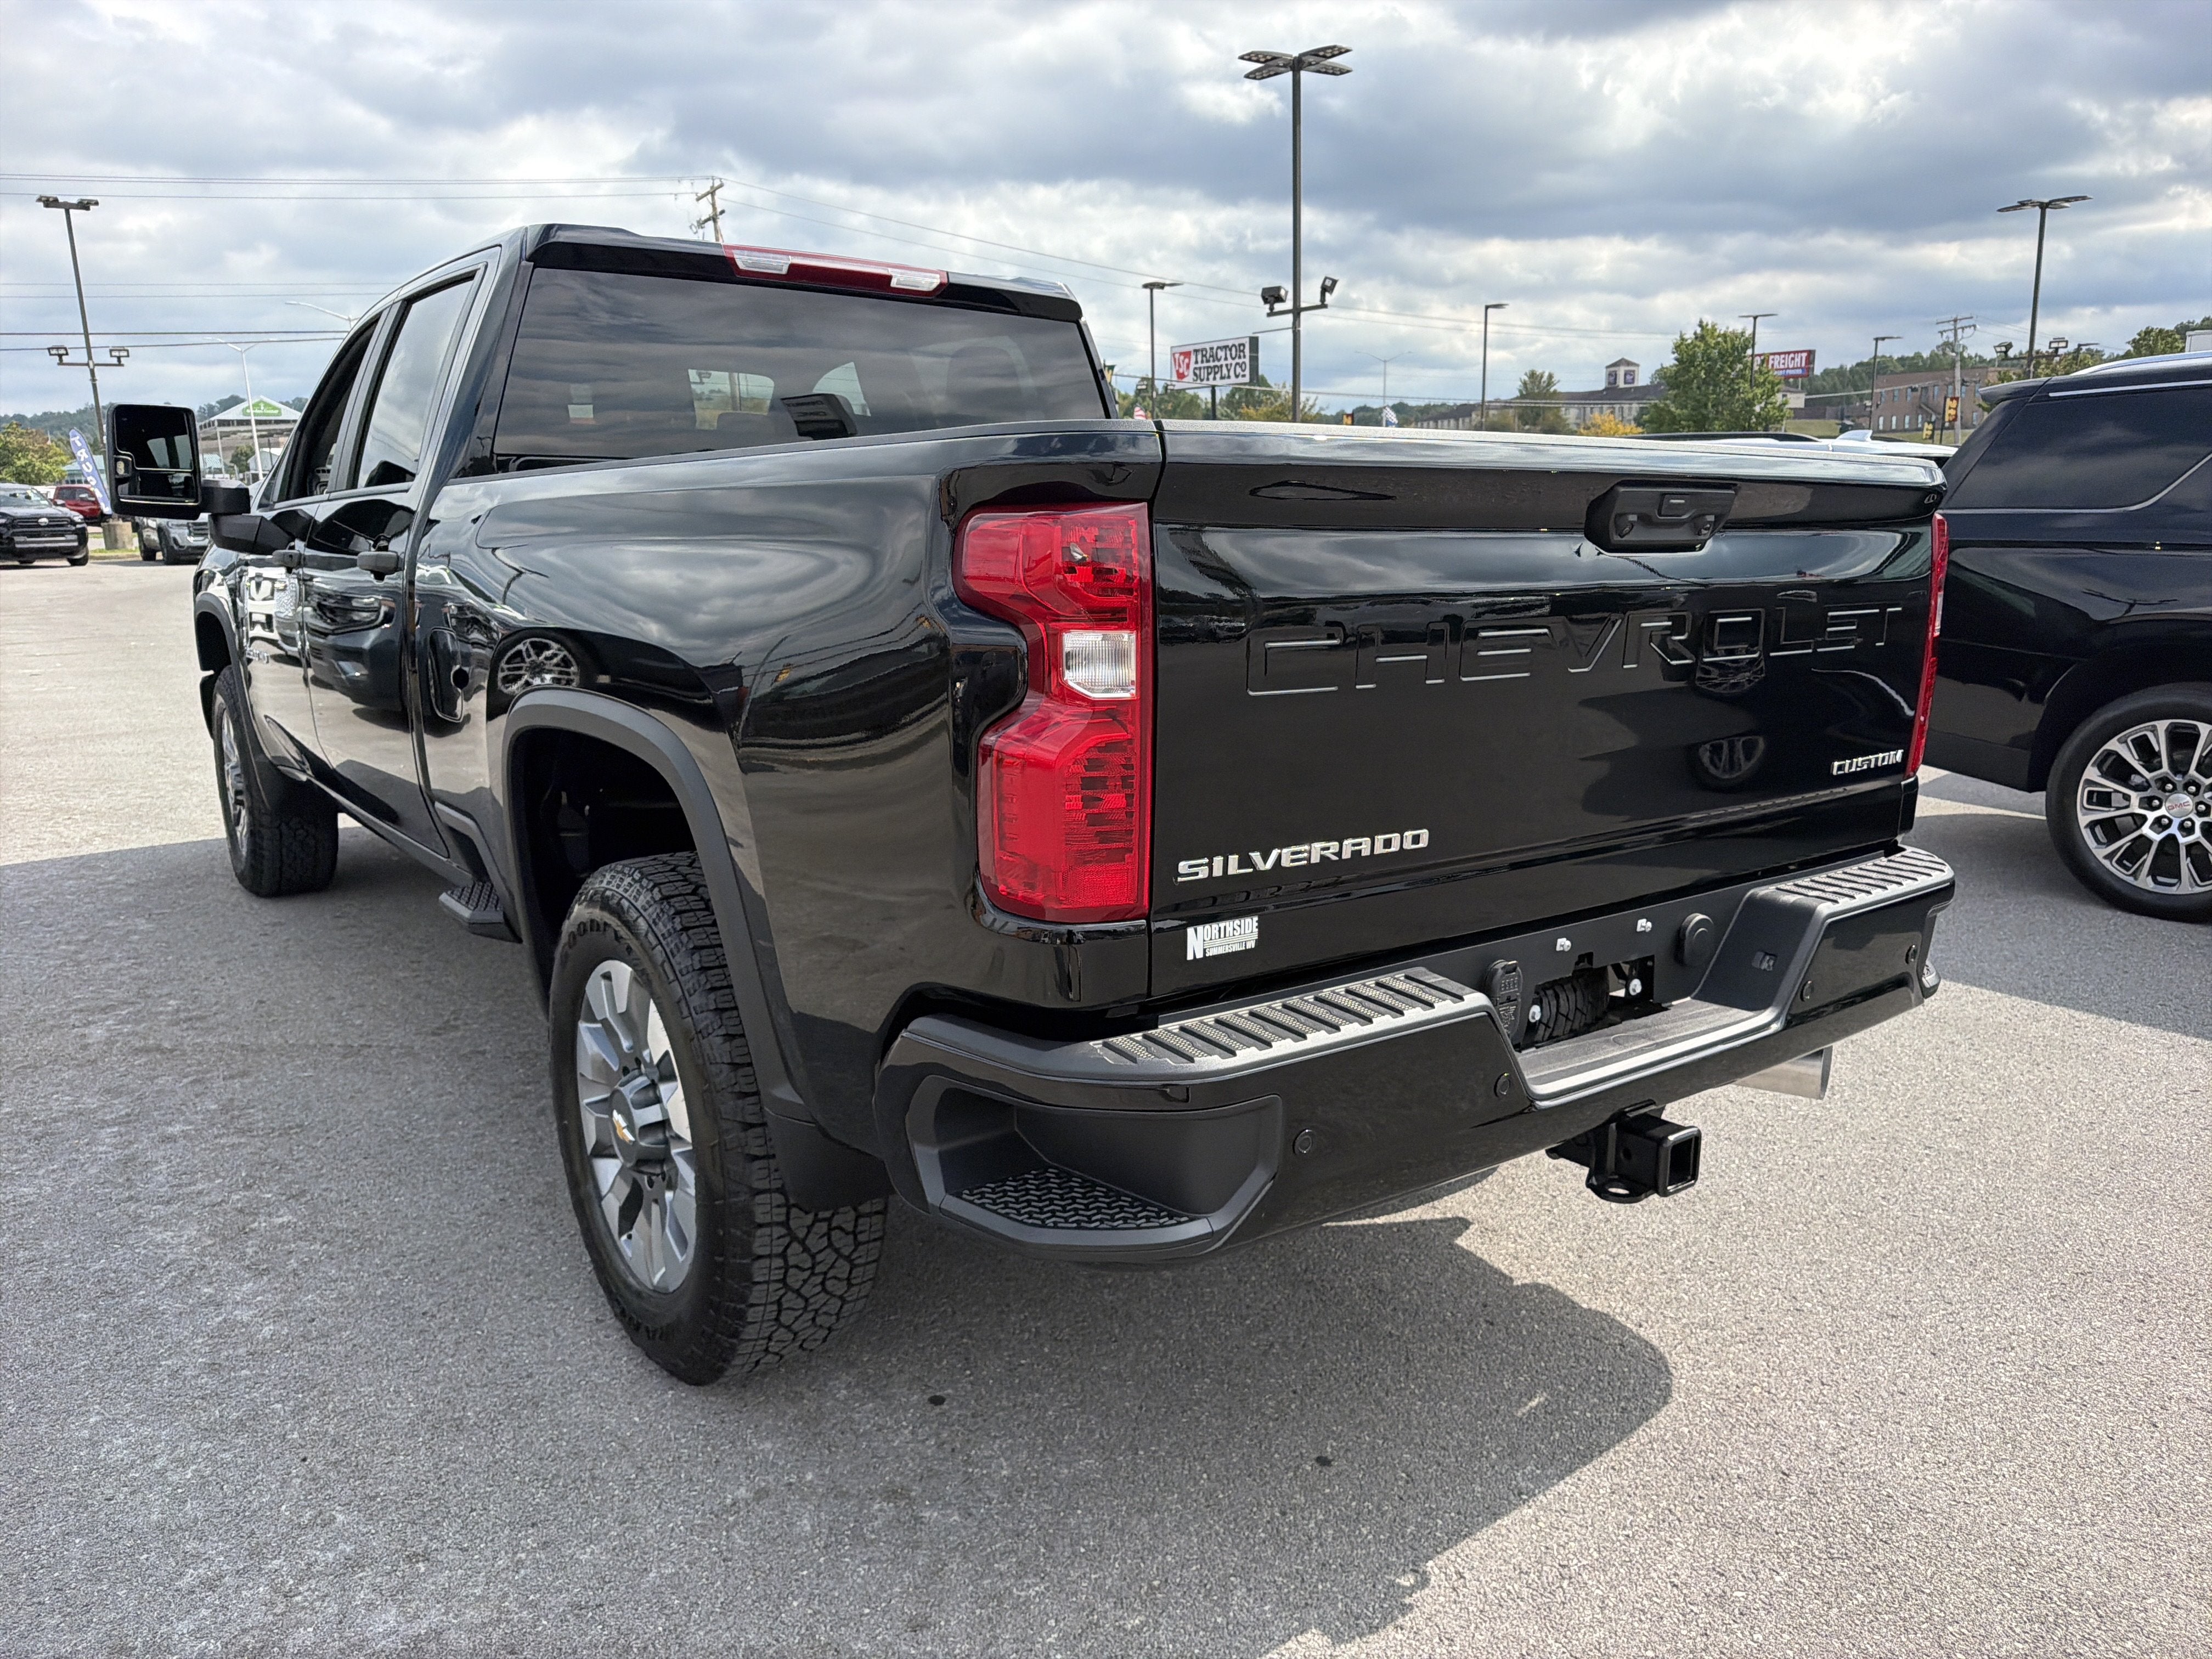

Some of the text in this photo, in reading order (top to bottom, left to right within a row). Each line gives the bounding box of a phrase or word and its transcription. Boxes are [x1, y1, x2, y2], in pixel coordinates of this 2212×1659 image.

[1193, 343, 1246, 364] TRACTOR
[1768, 352, 1808, 369] FREIGHT
[1193, 363, 1232, 382] SUPPLY
[1246, 602, 1903, 696] CHEVROLET
[1831, 749, 1904, 775] CUSTOM
[2168, 801, 2191, 810] GMC
[1177, 828, 1429, 882] SILVERADO
[1187, 916, 1258, 960] NORTHSIDE
[1206, 940, 1256, 957] SUMMERSVILLE WV
